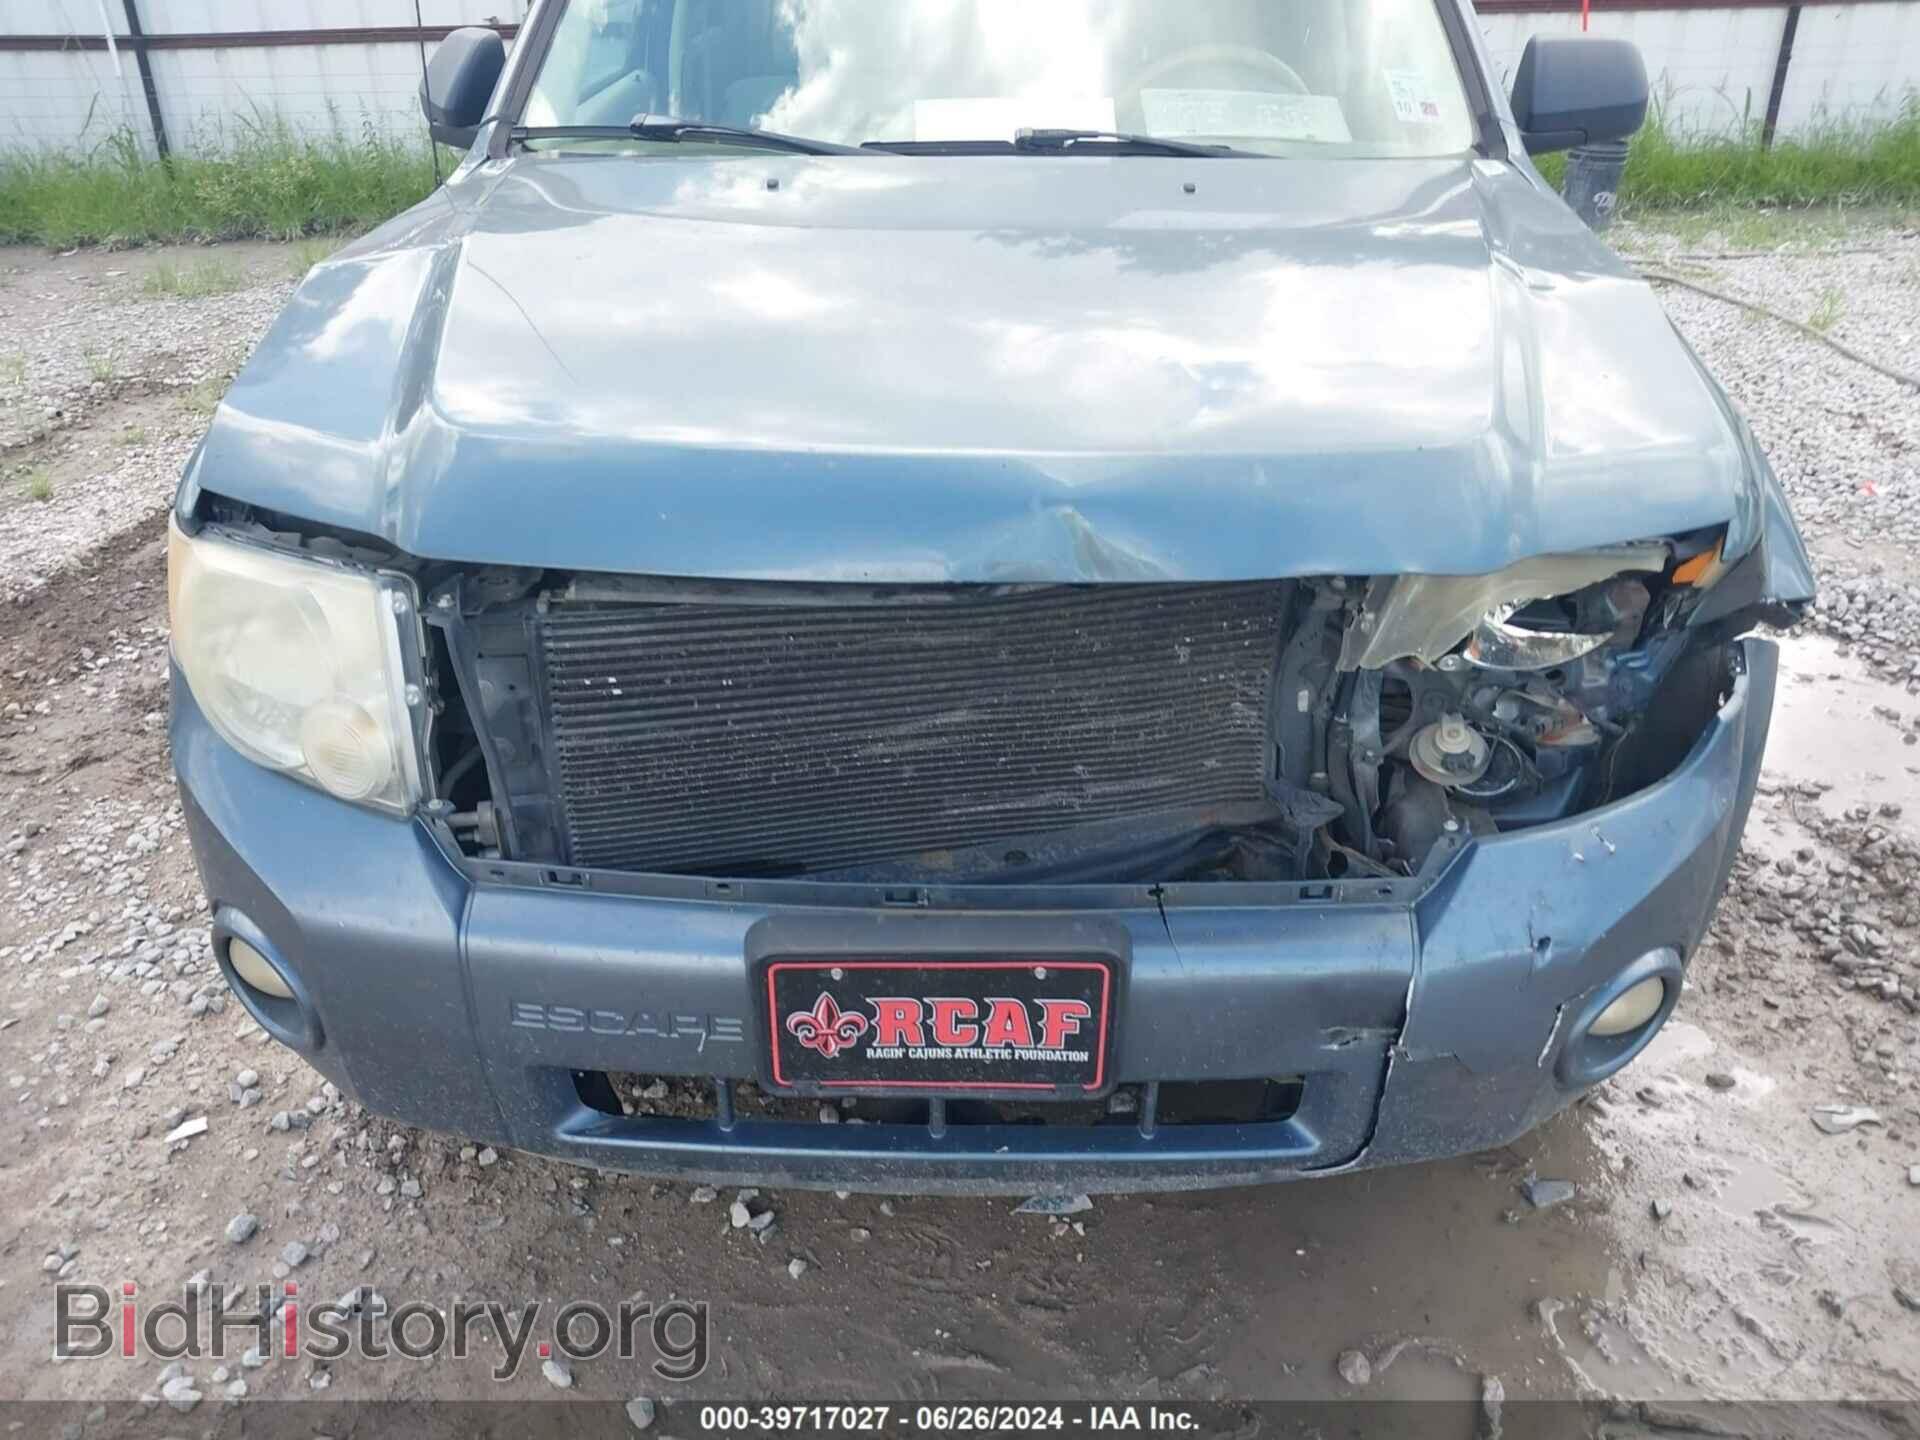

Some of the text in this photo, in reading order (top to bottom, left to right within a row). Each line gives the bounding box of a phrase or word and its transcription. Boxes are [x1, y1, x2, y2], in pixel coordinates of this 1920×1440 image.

[511, 1002, 744, 1042] ESCAPE
[866, 997, 1092, 1050] RCAF
[908, 1047, 952, 1061] CAJUNS
[954, 1048, 1012, 1061] ATHLETIC
[1014, 1049, 1089, 1063] FOUNDATION
